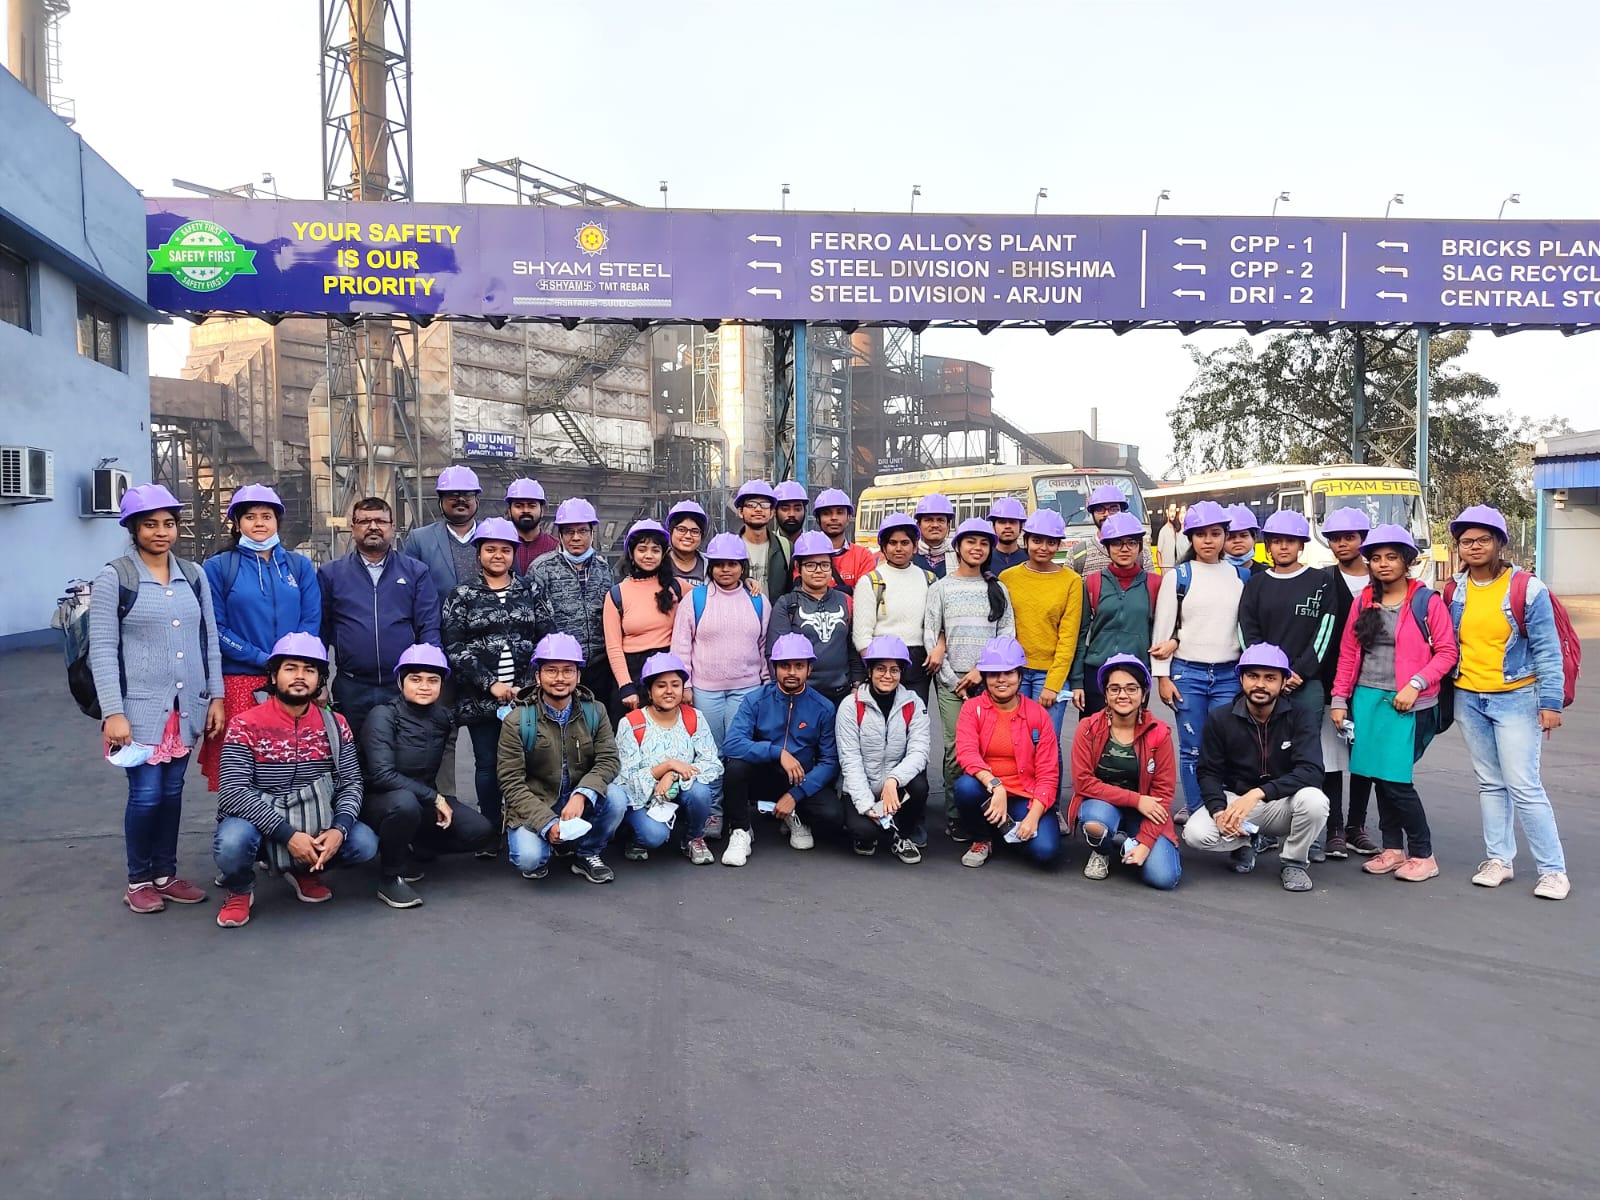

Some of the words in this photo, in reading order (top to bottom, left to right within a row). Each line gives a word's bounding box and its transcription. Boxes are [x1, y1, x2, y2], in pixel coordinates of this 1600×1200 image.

[180, 224, 202, 236] SAFETY
[204, 224, 222, 236] FIRST
[292, 222, 362, 242] YOUR
[368, 223, 462, 244] SAFETY
[810, 232, 891, 251] FERRO
[898, 232, 992, 252] ALLOYS
[1000, 234, 1076, 252] PLANT
[1230, 236, 1279, 254] CPP
[1303, 236, 1313, 254] 1
[1441, 239, 1531, 257] BRICKS
[1540, 240, 1600, 257] PLAN
[168, 250, 206, 262] SAFETY
[208, 250, 236, 262] FIRST
[337, 248, 360, 268] IS
[366, 249, 419, 270] OUR
[512, 260, 592, 276] SHYAM
[598, 262, 672, 278] STEEL
[810, 259, 883, 278] STEEL
[890, 260, 990, 278] DIVISION
[1012, 260, 1116, 278] BHISHMA
[1230, 260, 1278, 278] CPP
[1302, 261, 1313, 278] 2
[1442, 264, 1503, 282] SLAG
[1510, 265, 1600, 282] RECYCL
[182, 276, 204, 289] SAFETY
[206, 276, 224, 289] FIRST
[324, 275, 436, 296] PRIORITY
[549, 280, 583, 290] SHYAM
[598, 282, 618, 291] TMT
[620, 282, 650, 292] REBAR
[810, 286, 882, 304] STEEL
[890, 286, 986, 304] DIVISION
[1006, 286, 1082, 304] ARJUN
[1230, 286, 1274, 304] DRI
[1299, 286, 1313, 304] 2
[1440, 290, 1555, 307] CENTRAL
[467, 433, 486, 443] DRI
[489, 434, 514, 444] UNIT
[1316, 481, 1377, 492] SHYAM
[1382, 482, 1422, 492] STEEL
